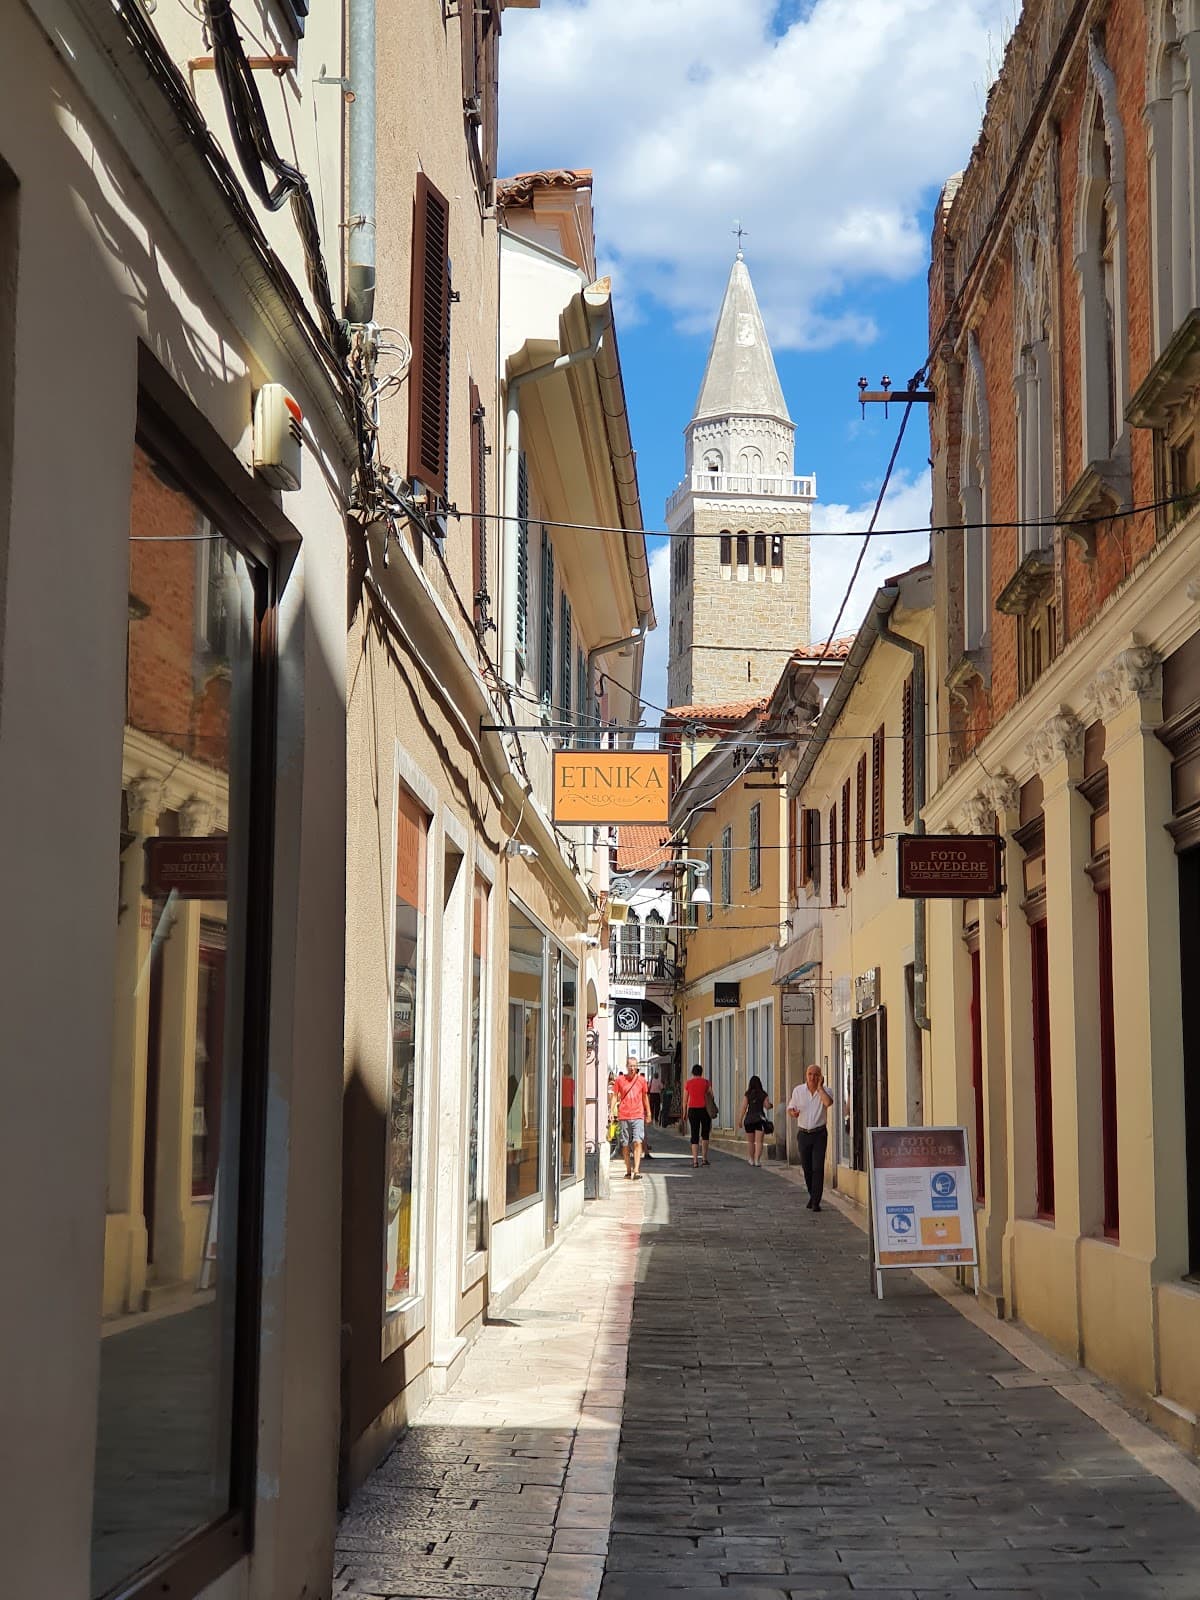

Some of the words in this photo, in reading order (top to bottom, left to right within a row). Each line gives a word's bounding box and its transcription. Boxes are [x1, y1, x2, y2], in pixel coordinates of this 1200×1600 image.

[561, 766, 663, 788] ETNIKA
[930, 851, 967, 860] FOTO
[910, 861, 989, 871] BELVEDERE
[901, 1136, 934, 1146] FOTO
[881, 1145, 956, 1156] BELVEDERE
